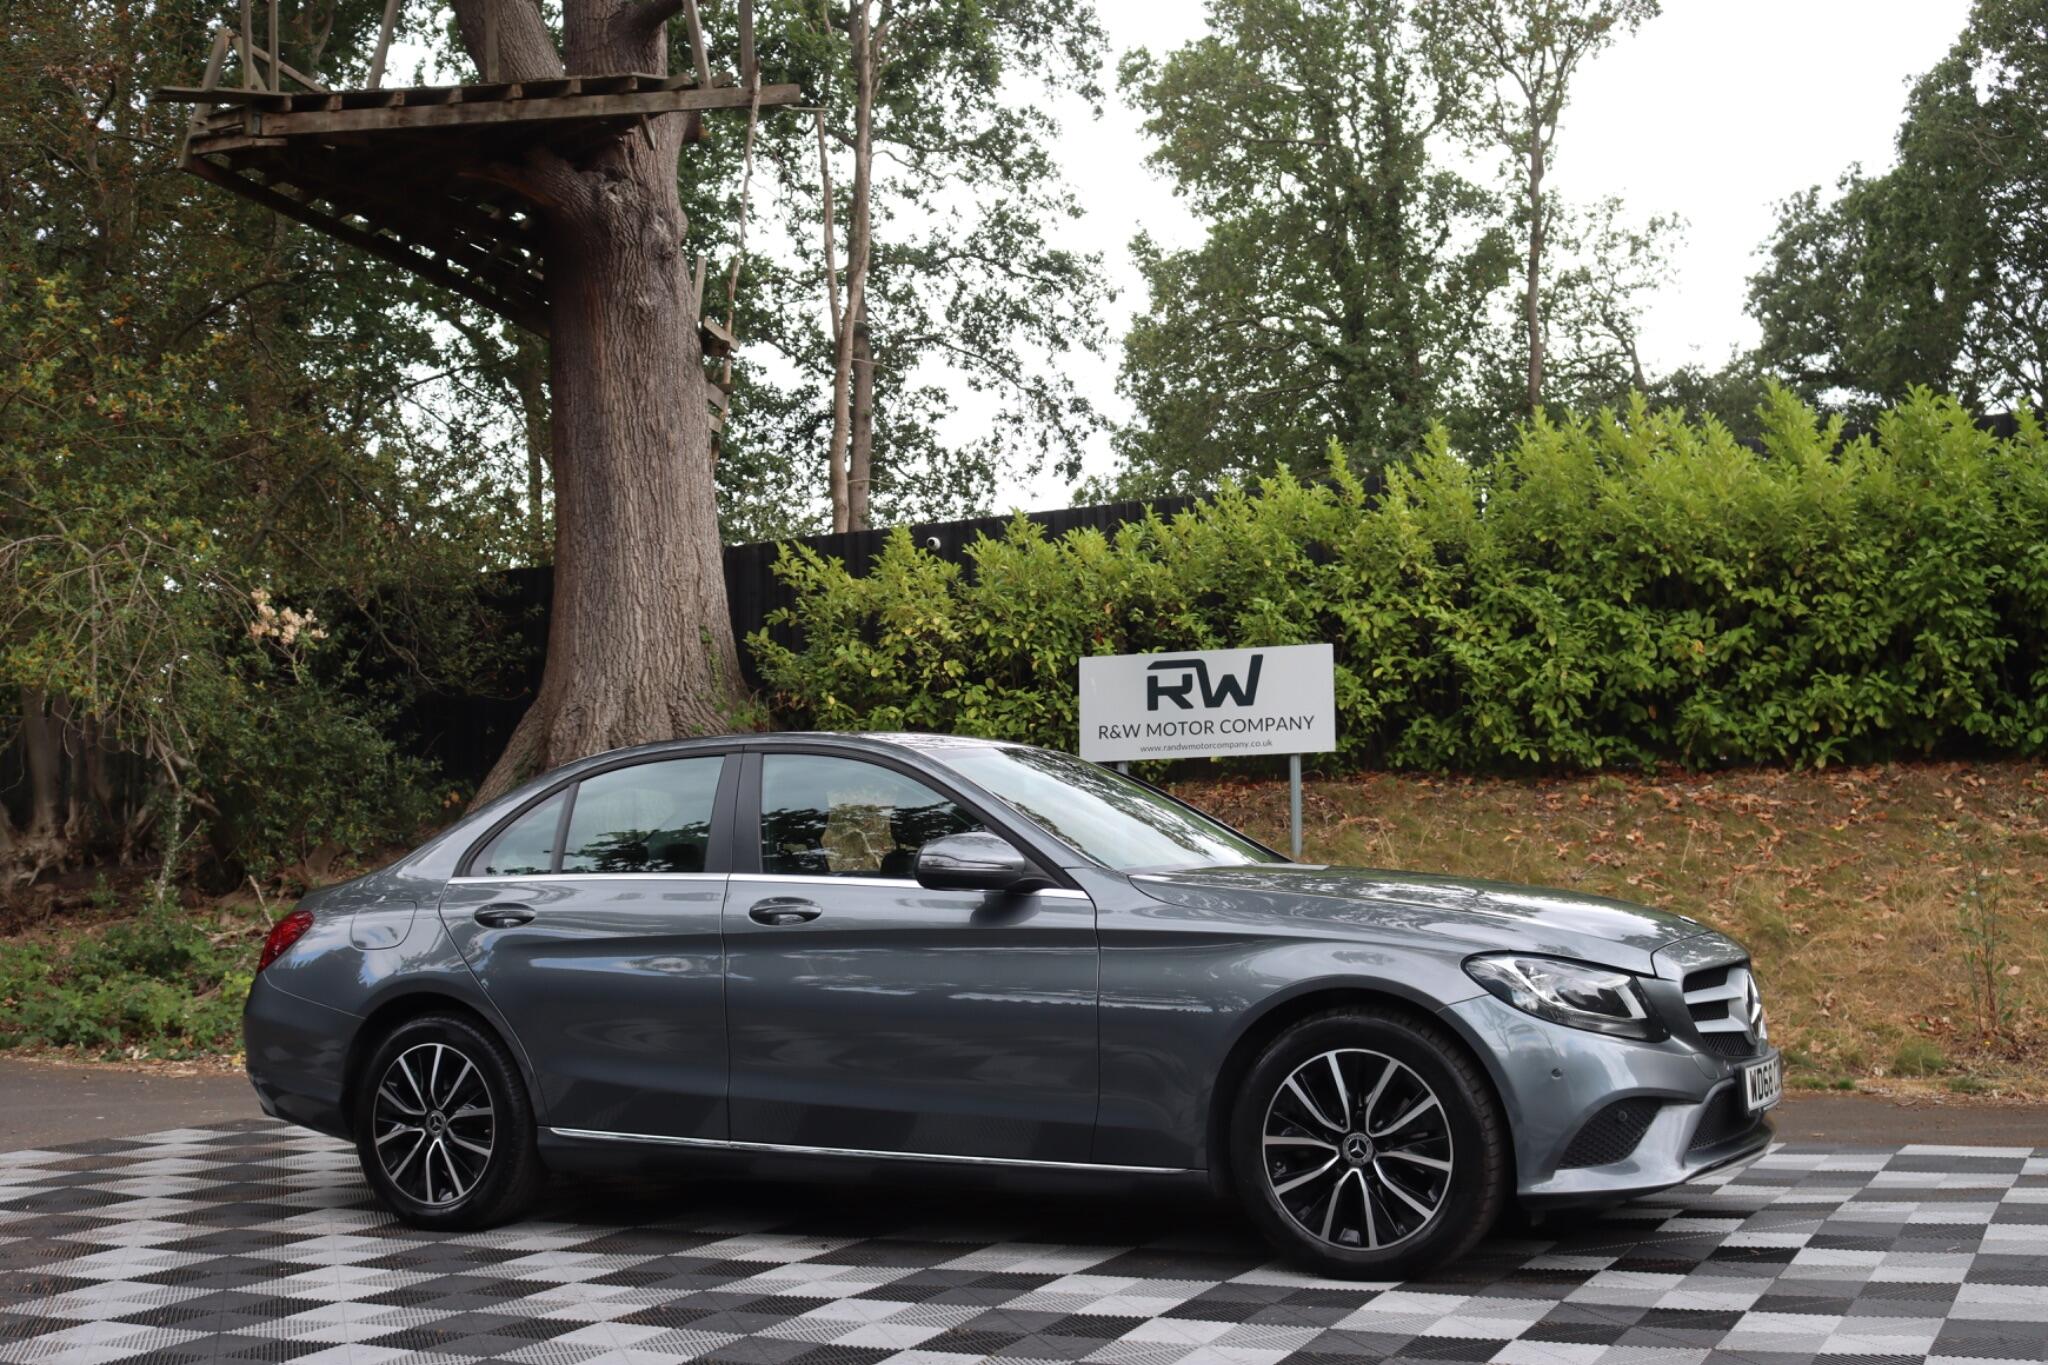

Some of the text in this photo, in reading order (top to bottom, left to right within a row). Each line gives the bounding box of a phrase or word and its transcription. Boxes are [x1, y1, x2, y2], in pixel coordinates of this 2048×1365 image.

[1147, 654, 1263, 711] RW
[1098, 715, 1315, 740] R&W MOTOR COMPANY
[1140, 739, 1273, 753] www.randwmotorcompany.co.uk
